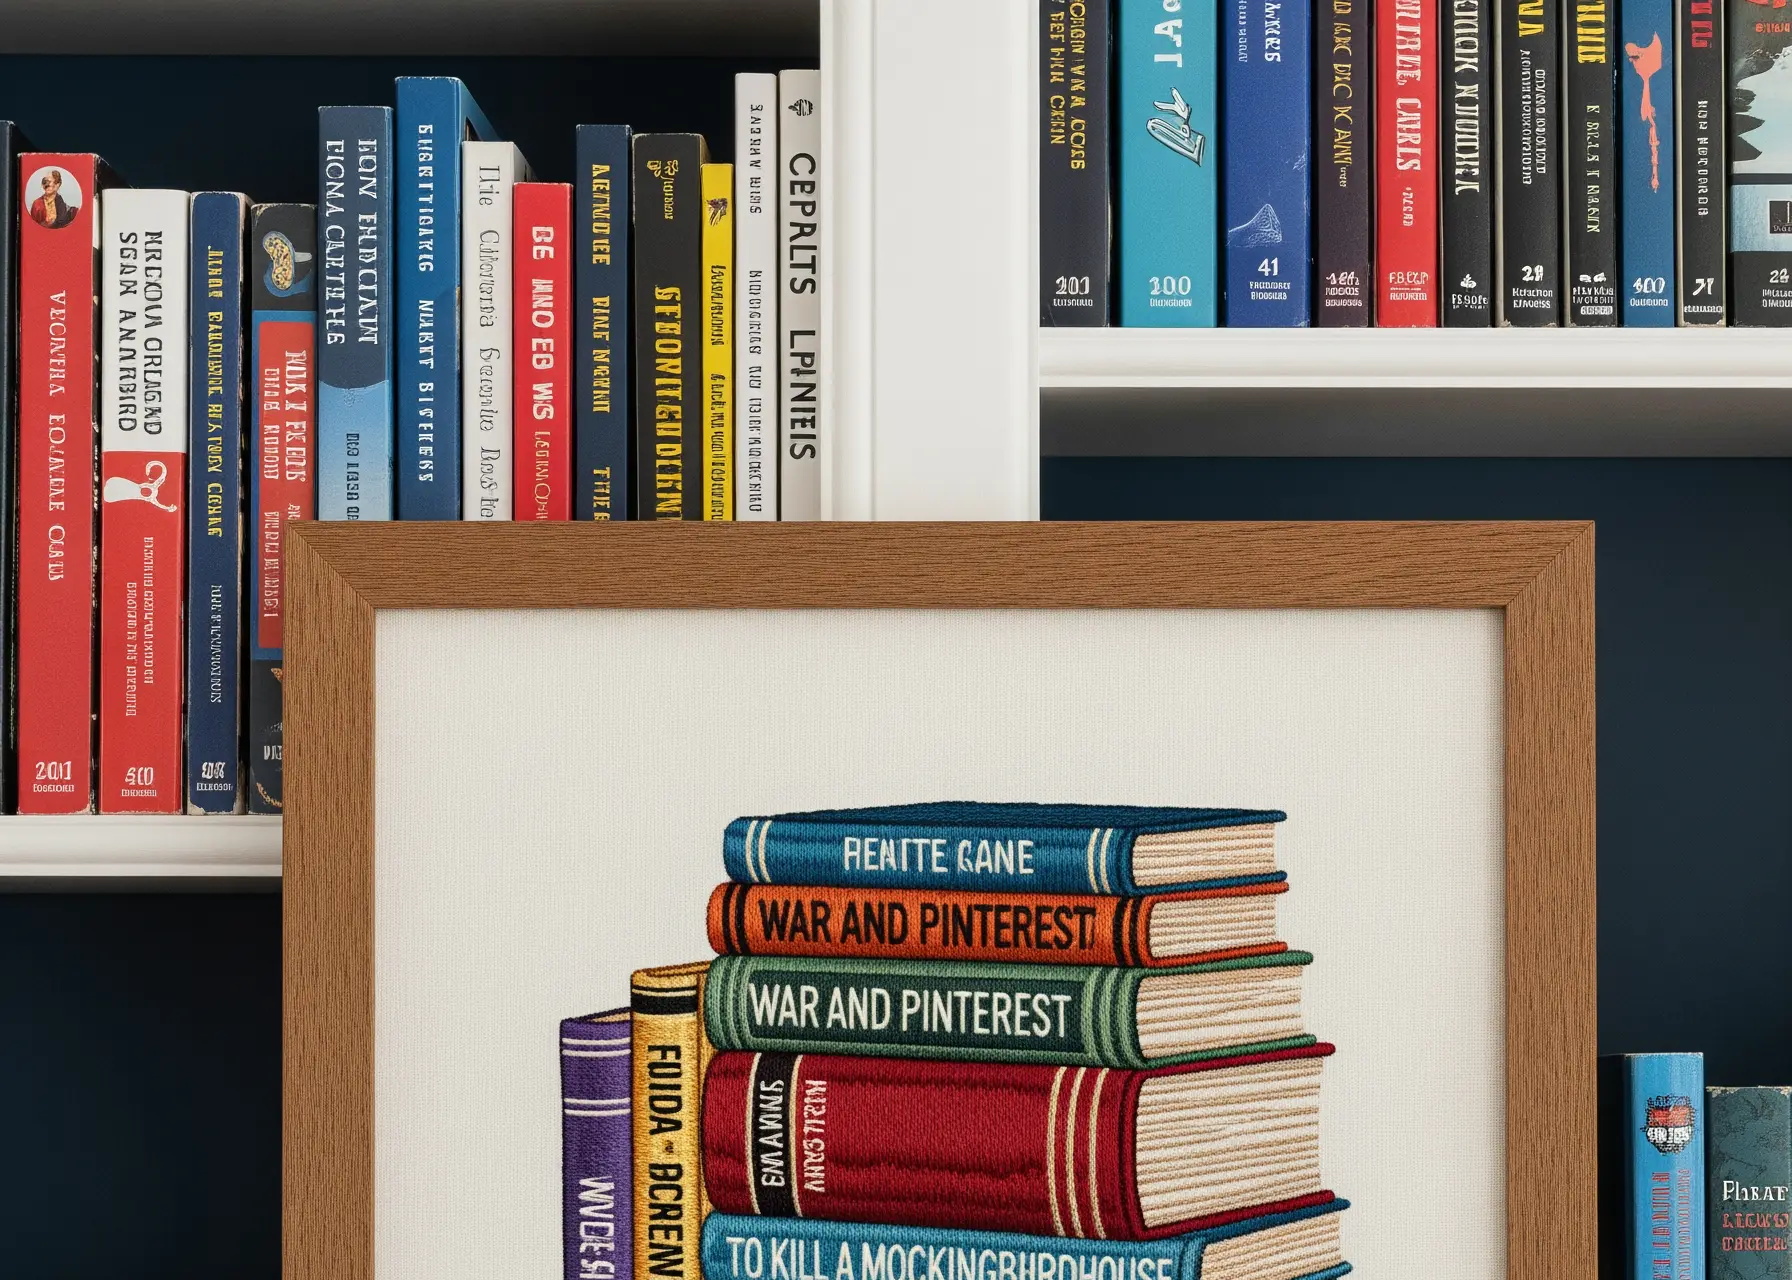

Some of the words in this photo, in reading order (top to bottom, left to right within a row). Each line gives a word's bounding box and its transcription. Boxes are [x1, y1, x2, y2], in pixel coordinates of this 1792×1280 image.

[1257, 256, 1279, 277] 41
[757, 897, 832, 944] WAR
[840, 901, 909, 946] AND
[920, 903, 1097, 951] PINTEREST
[748, 982, 819, 1030] WAR
[826, 986, 891, 1031] AND
[901, 989, 1073, 1039] PINTEREST
[725, 1236, 763, 1280] TO
